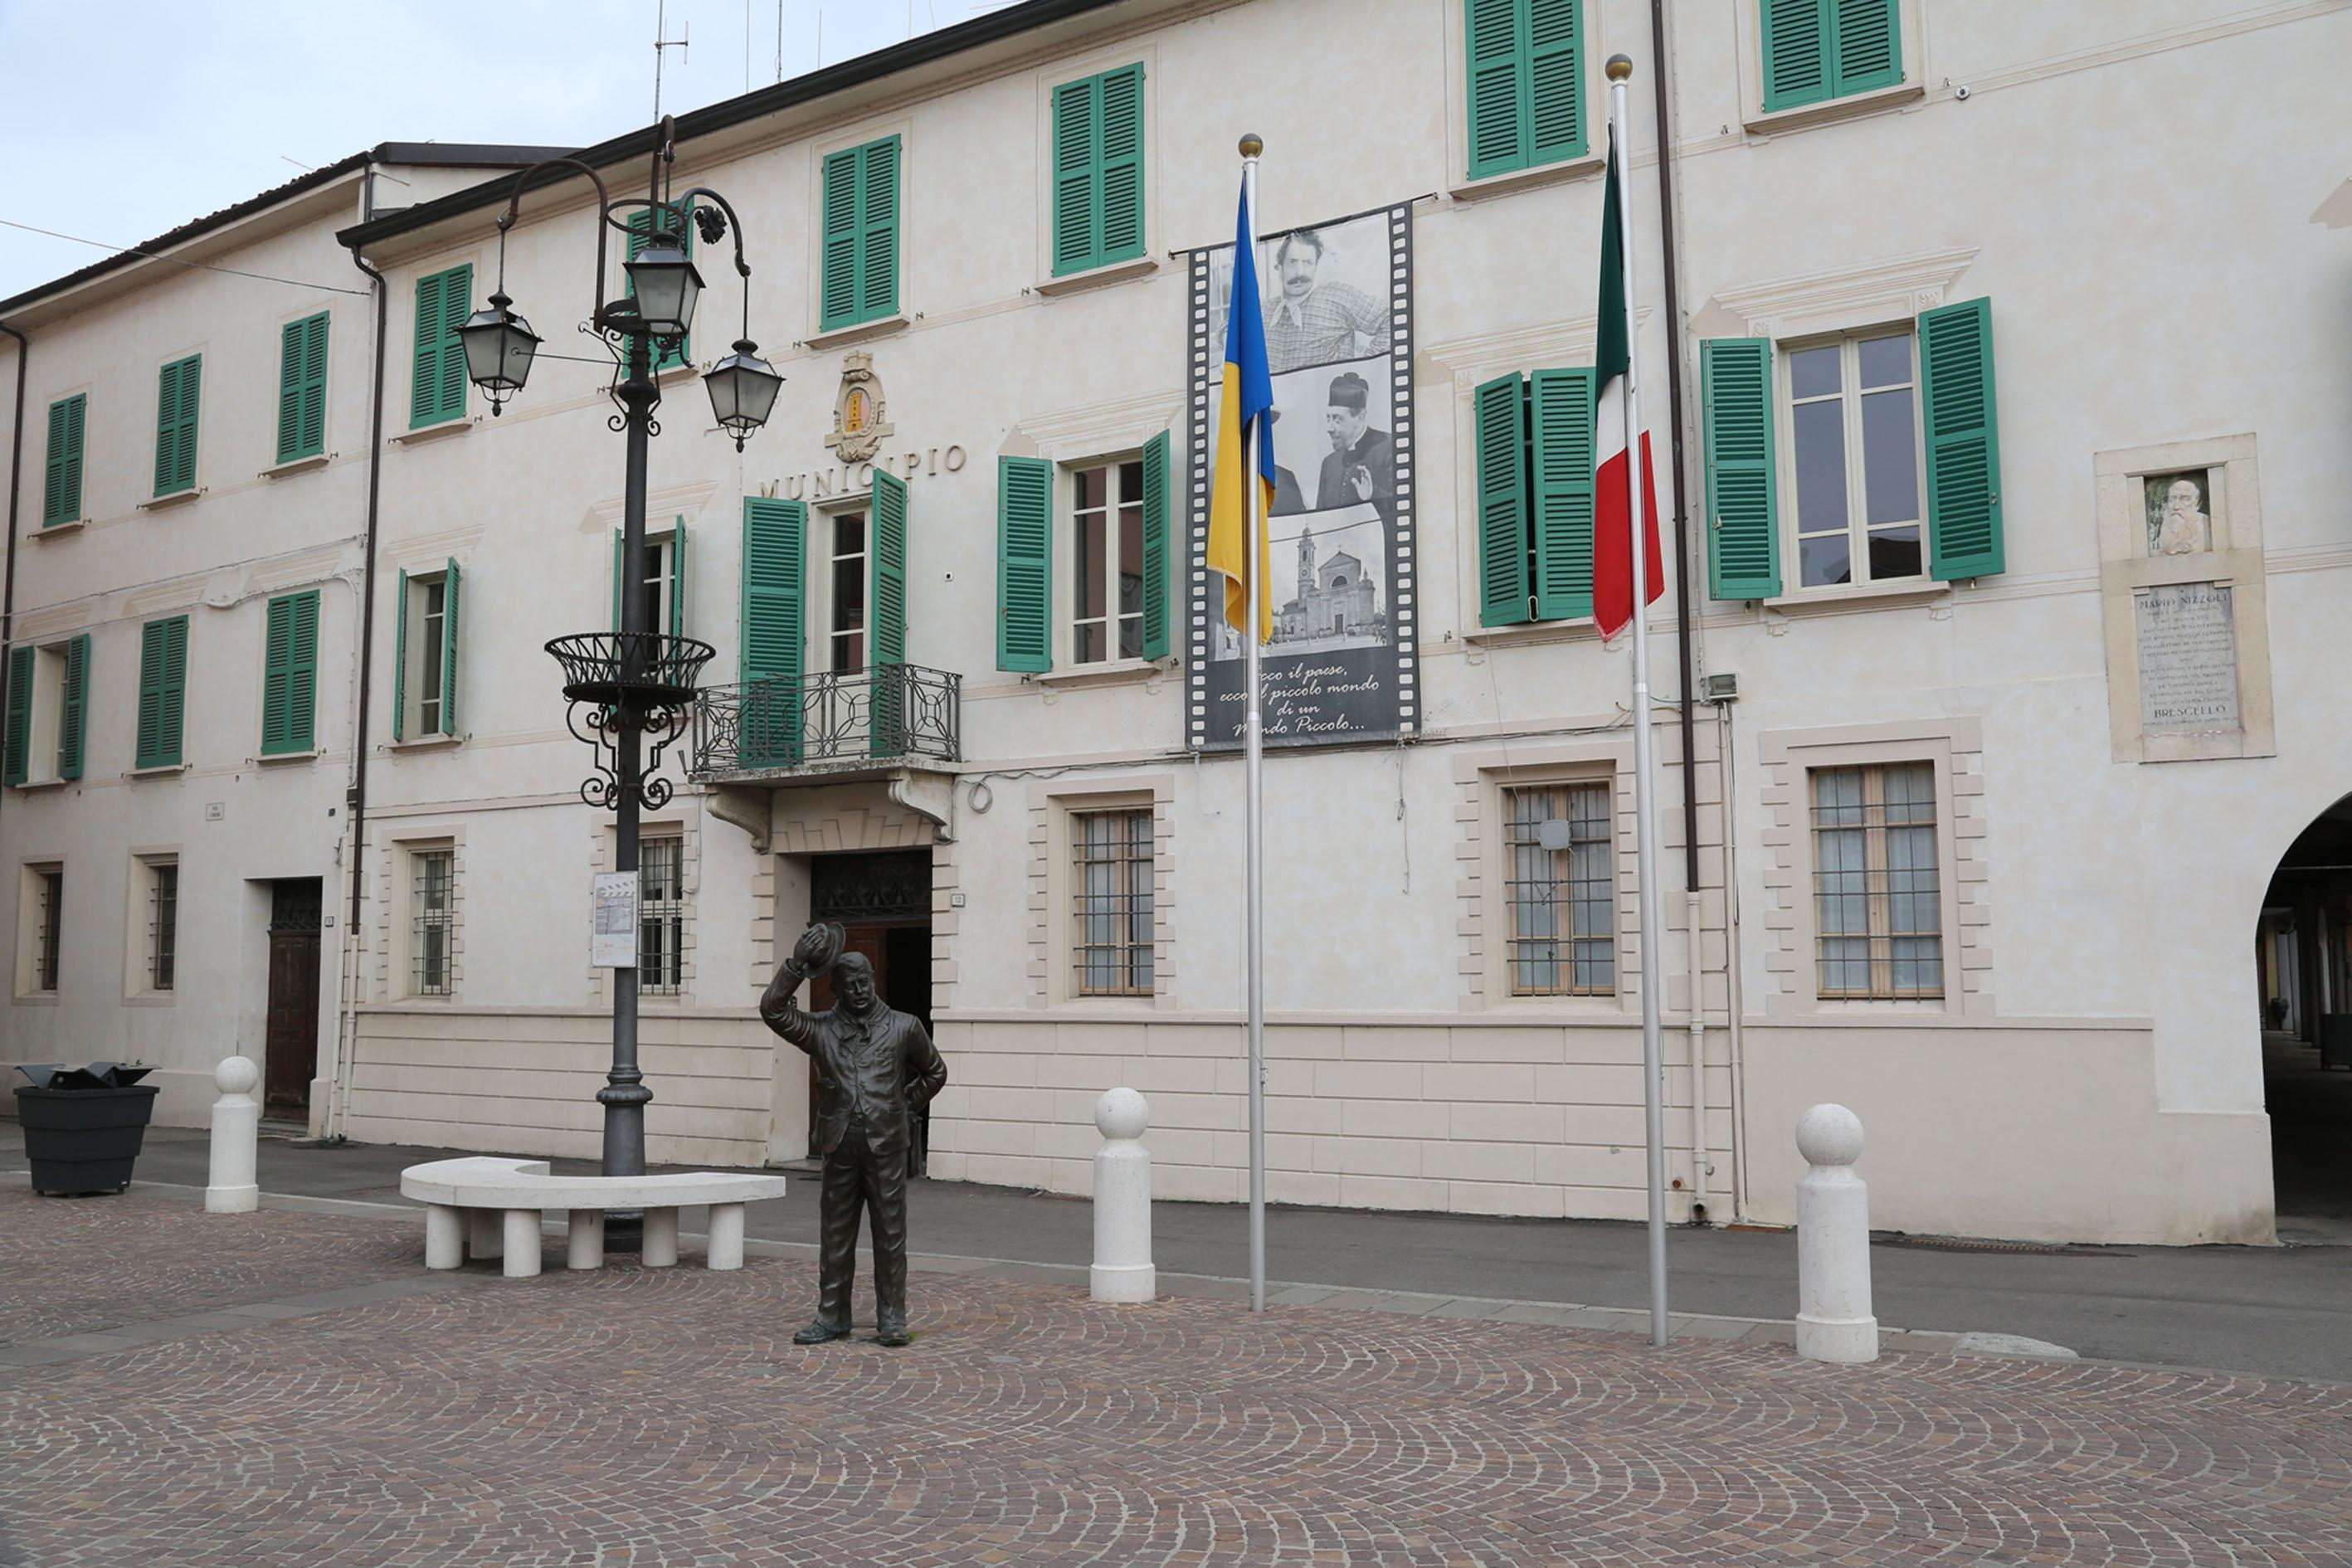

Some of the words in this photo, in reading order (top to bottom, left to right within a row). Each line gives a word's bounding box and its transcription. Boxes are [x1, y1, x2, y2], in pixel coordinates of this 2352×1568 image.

[760, 445, 967, 500] MUNICIPIO
[2140, 598, 2175, 609] MARIO
[2181, 594, 2227, 605] NIZZOLI
[1288, 663, 1303, 679] il
[1303, 664, 1348, 684] paese,
[1220, 692, 1249, 702] ecco
[1268, 679, 1322, 705] piccolo
[1327, 674, 1379, 692] mondo
[1277, 700, 1294, 716] di
[1298, 704, 1321, 715] un
[2154, 705, 2226, 718] BRESCELLO
[1295, 713, 1365, 733] Piccolo...
